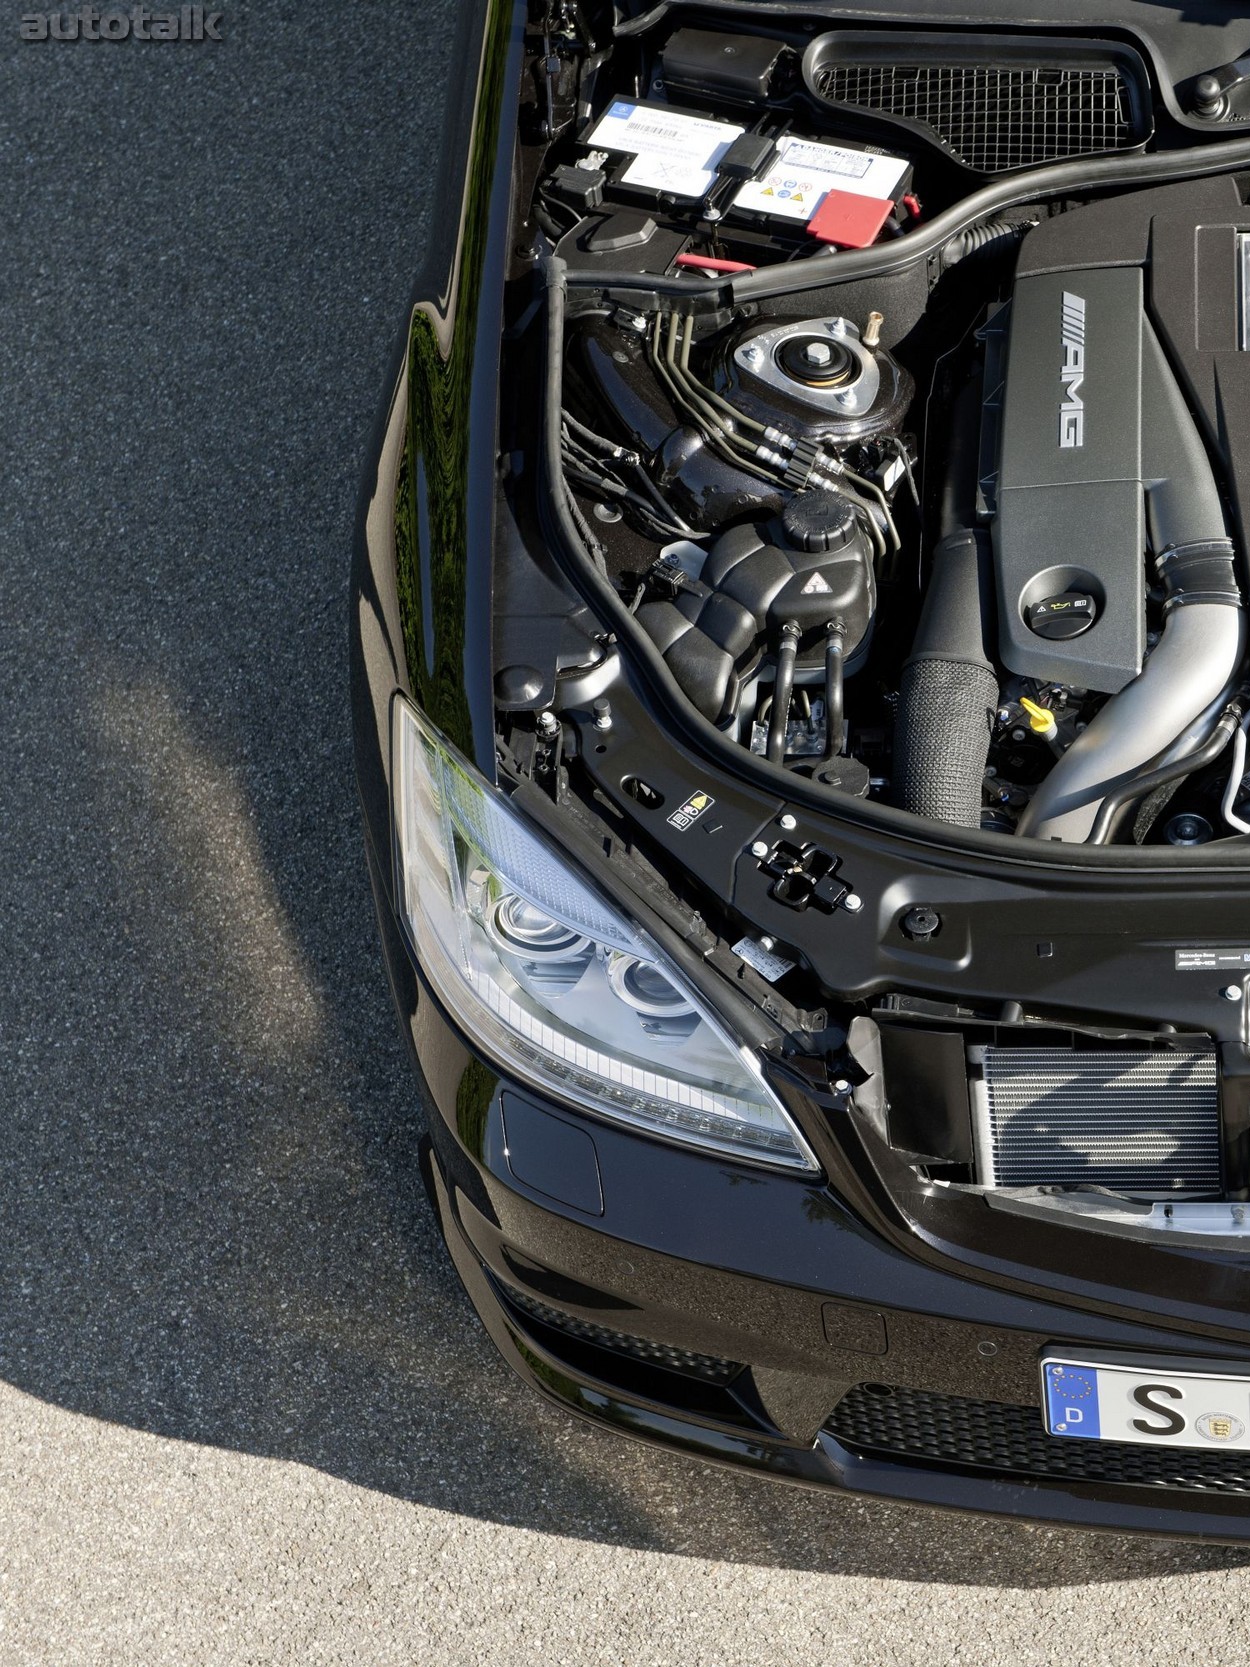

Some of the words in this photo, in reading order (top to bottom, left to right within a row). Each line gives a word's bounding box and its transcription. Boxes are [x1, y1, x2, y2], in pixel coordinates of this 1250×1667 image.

[1059, 335, 1085, 448] AMG
[1064, 1407, 1083, 1424] D
[1131, 1384, 1186, 1436] S
